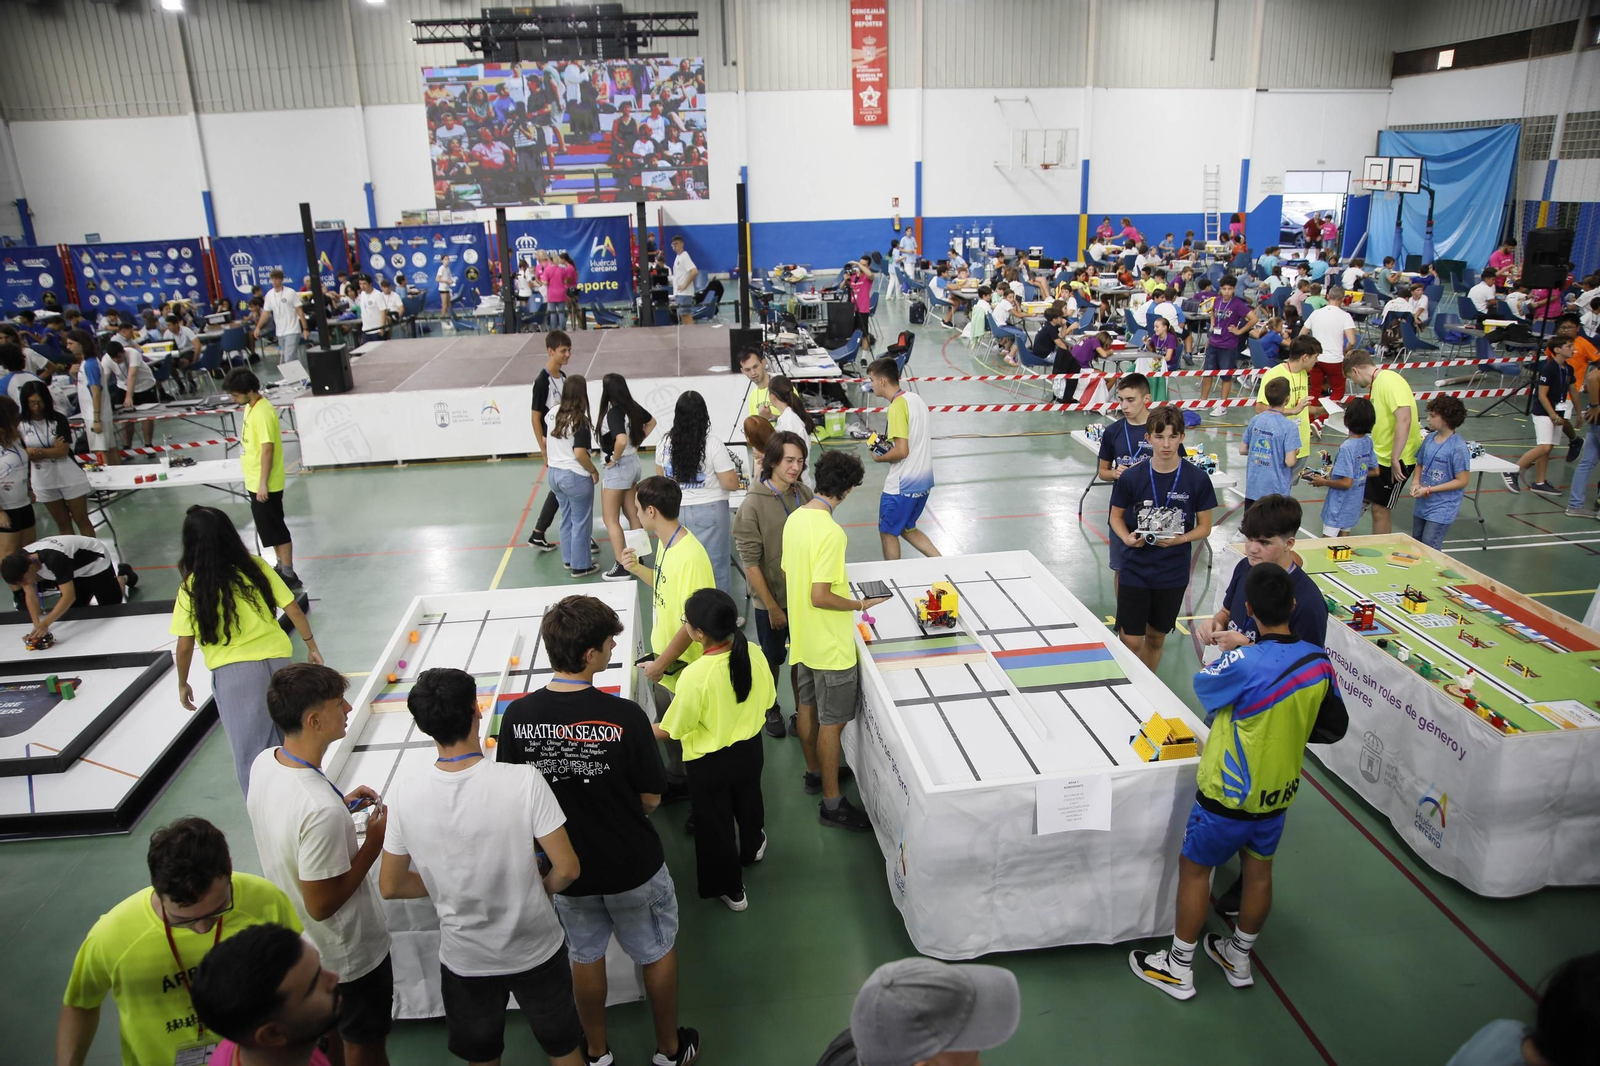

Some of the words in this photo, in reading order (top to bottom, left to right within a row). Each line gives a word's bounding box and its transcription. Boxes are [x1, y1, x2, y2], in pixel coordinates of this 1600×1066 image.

[590, 258, 617, 267] Huércal
[1323, 645, 1361, 680] onsable,
[1362, 674, 1378, 691] sin
[1378, 685, 1402, 709] roles
[1405, 703, 1417, 721] de
[1417, 716, 1457, 752] género
[1458, 747, 1467, 761] y
[1338, 676, 1374, 708] mujeres
[512, 723, 574, 740] MARATHON
[575, 725, 623, 742] SEASON
[557, 765, 570, 774] OF
[1414, 821, 1441, 849] cercano
[1415, 809, 1443, 842] Huércal
